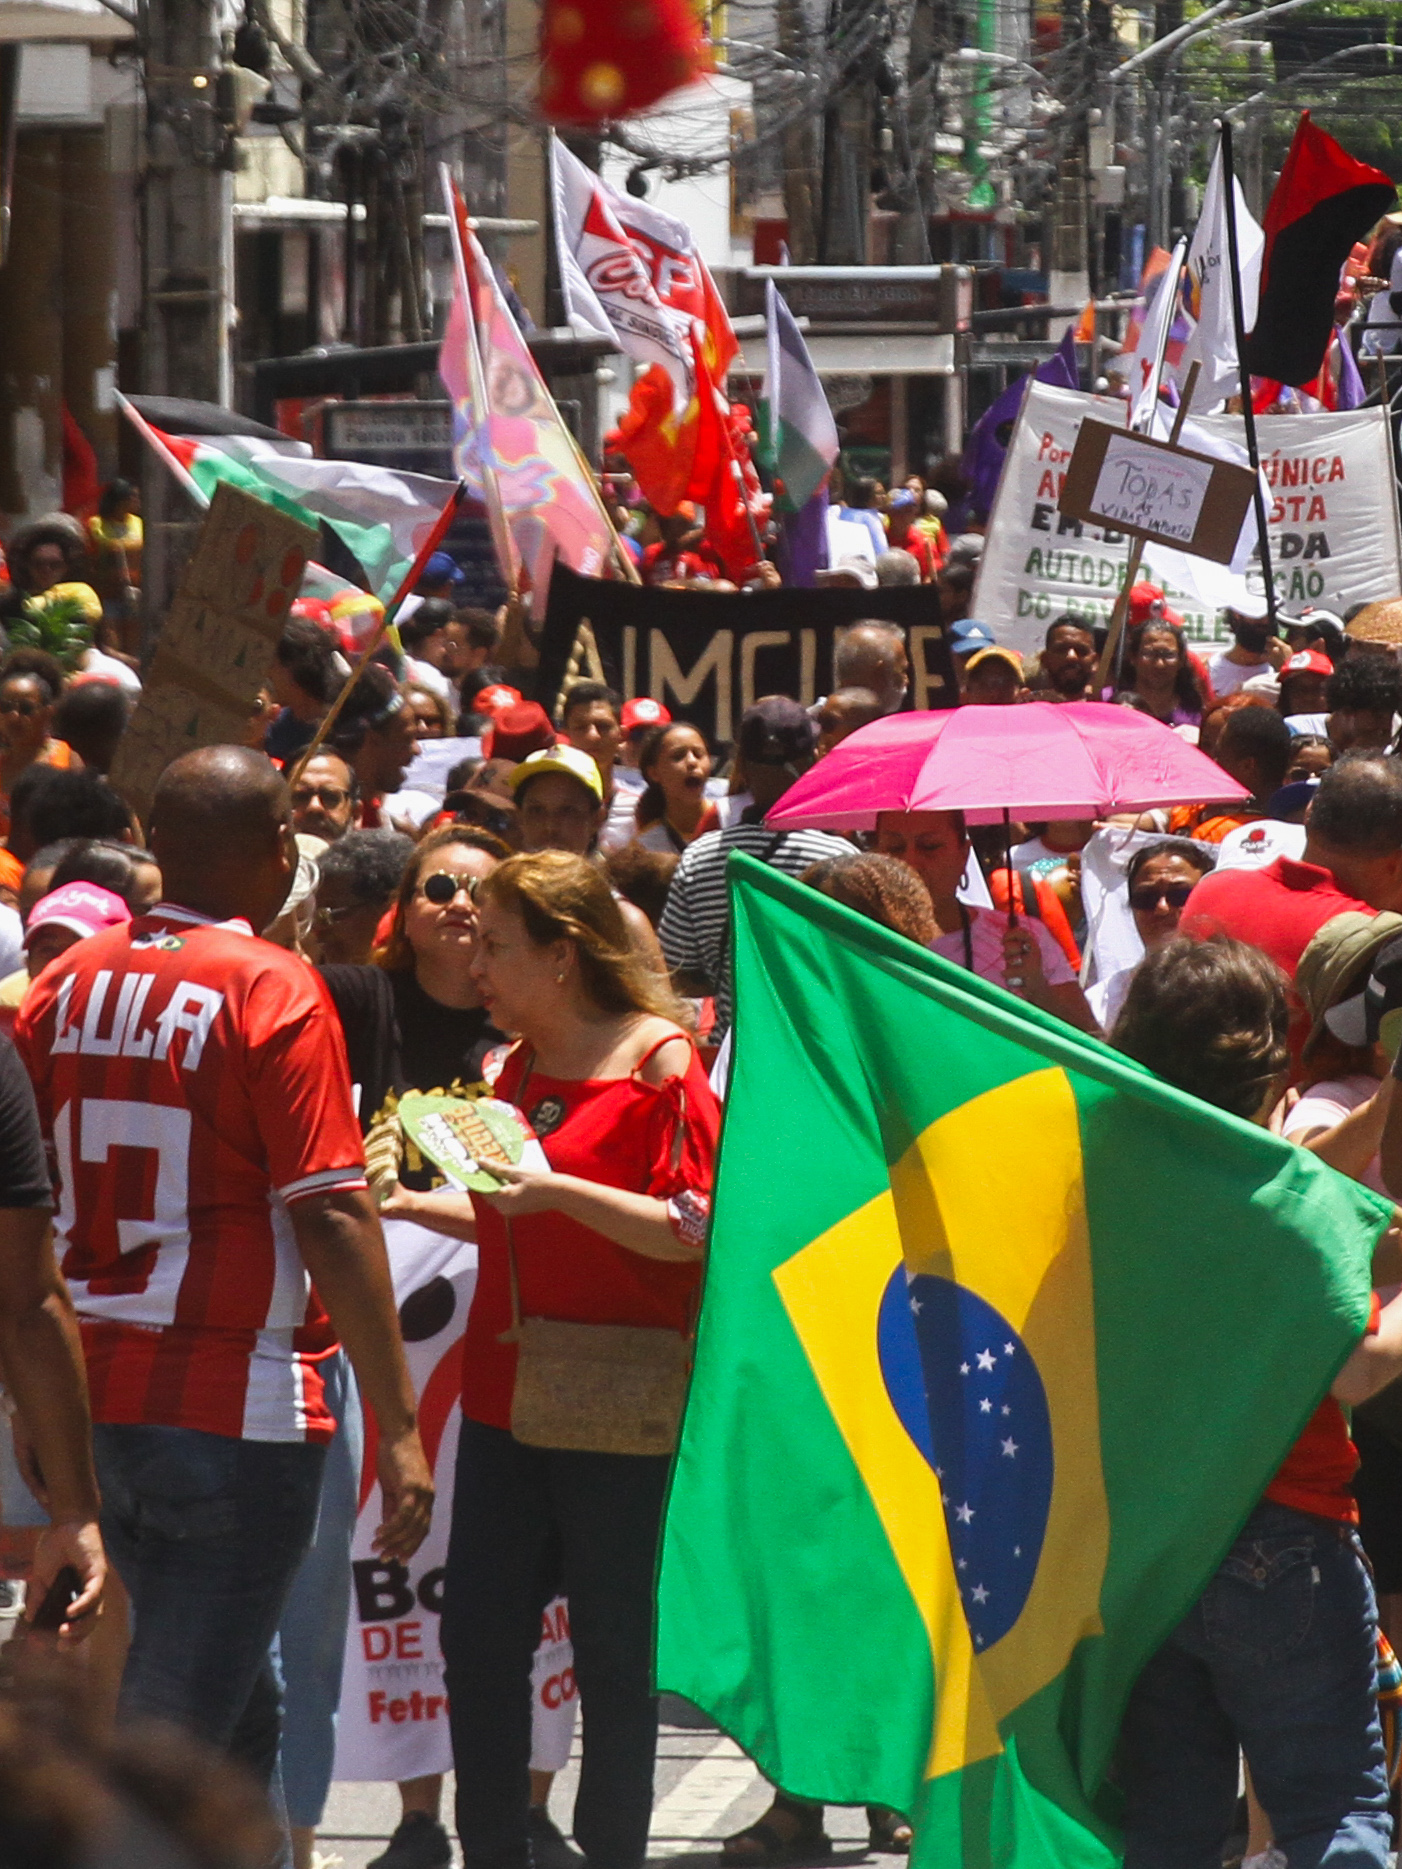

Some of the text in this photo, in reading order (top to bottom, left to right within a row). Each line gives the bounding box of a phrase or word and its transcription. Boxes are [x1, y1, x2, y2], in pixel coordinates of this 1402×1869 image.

[1115, 460, 1194, 510] TODAS
[1261, 449, 1347, 488] ÚNICA
[1101, 502, 1142, 526] VIDAS
[1016, 588, 1050, 620] DO
[50, 970, 225, 1072] LULA
[52, 1097, 193, 1326] 13
[361, 1621, 424, 1662] DE
